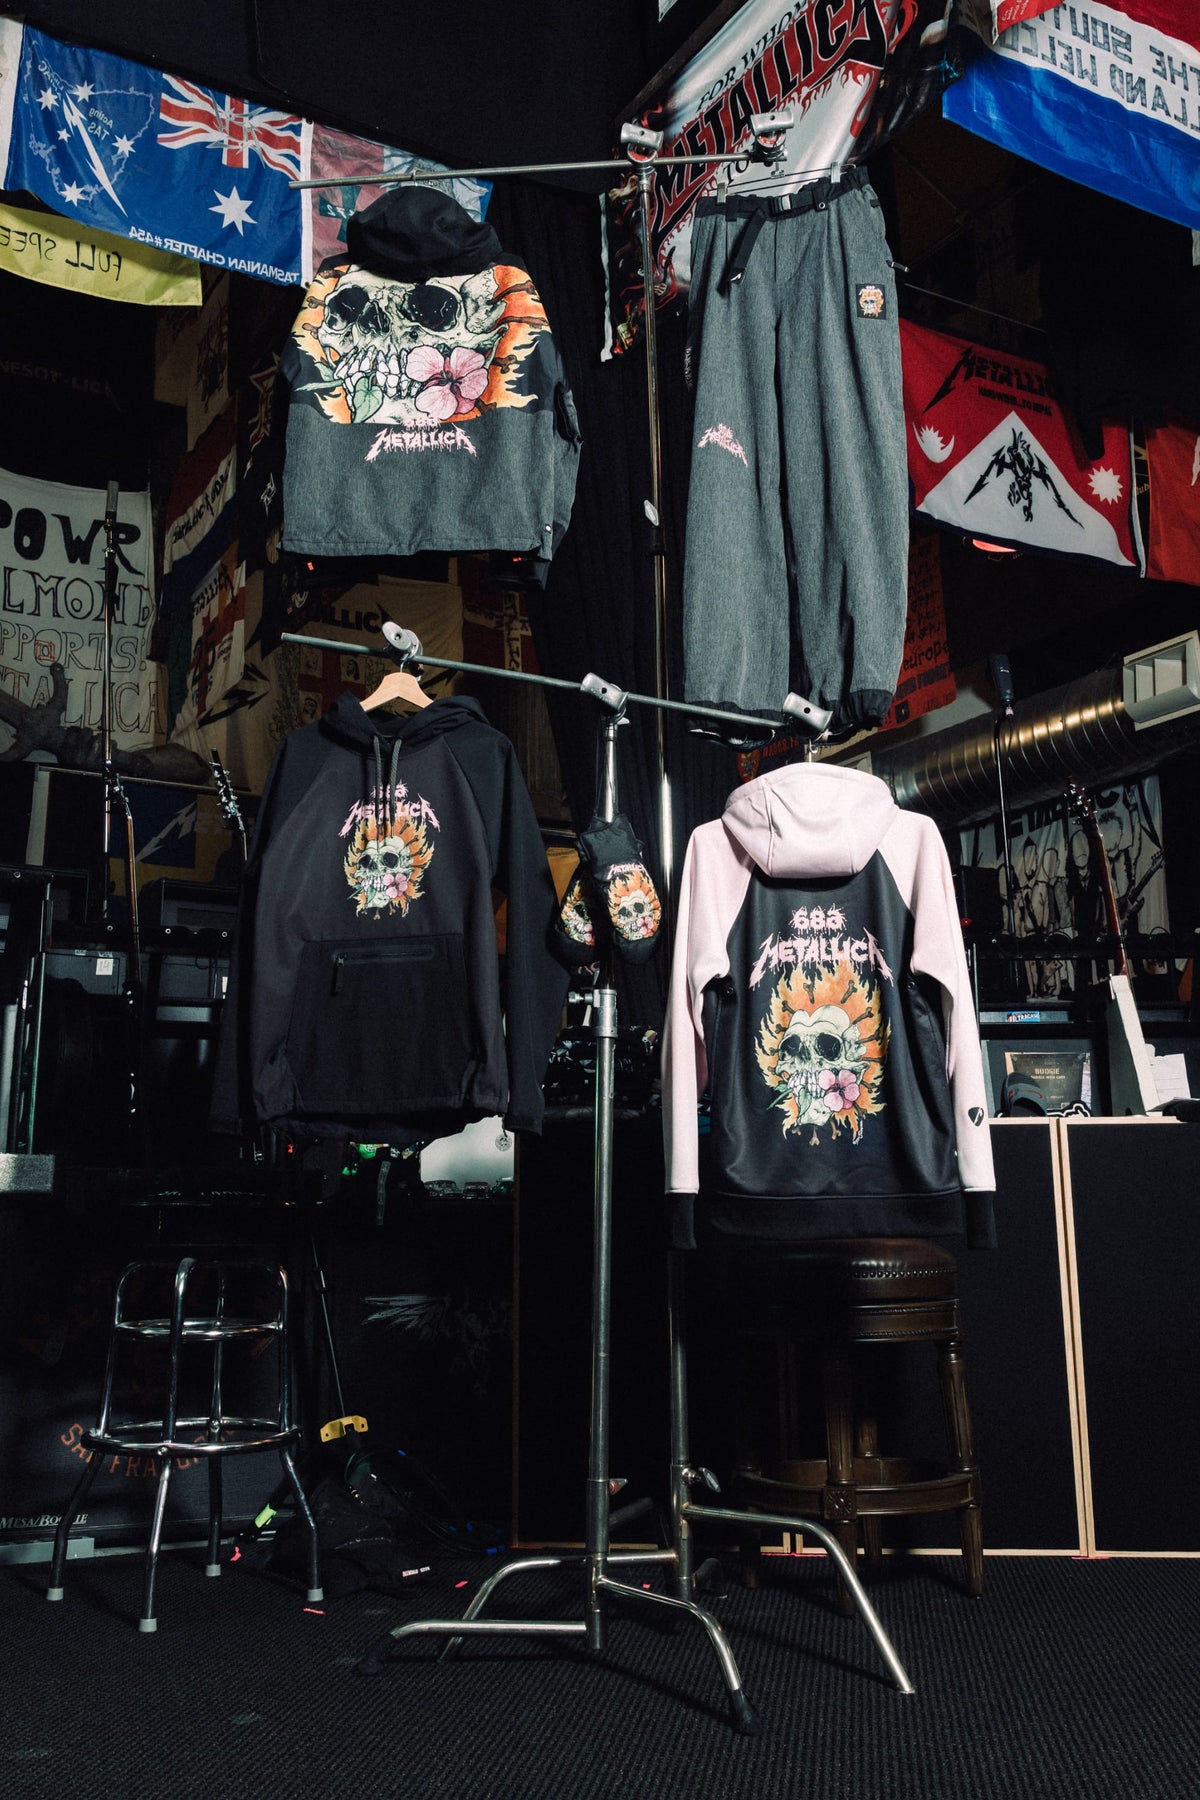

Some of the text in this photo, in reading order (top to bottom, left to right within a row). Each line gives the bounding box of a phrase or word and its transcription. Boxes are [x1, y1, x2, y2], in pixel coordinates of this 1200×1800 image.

[696, 66, 737, 112] FOR
[649, 0, 888, 241] METALLICA
[364, 423, 478, 462] METALLICA
[0, 664, 166, 736] TALLICA
[748, 926, 895, 991] METALLICA
[0, 1513, 89, 1529] MESA/BOIE
